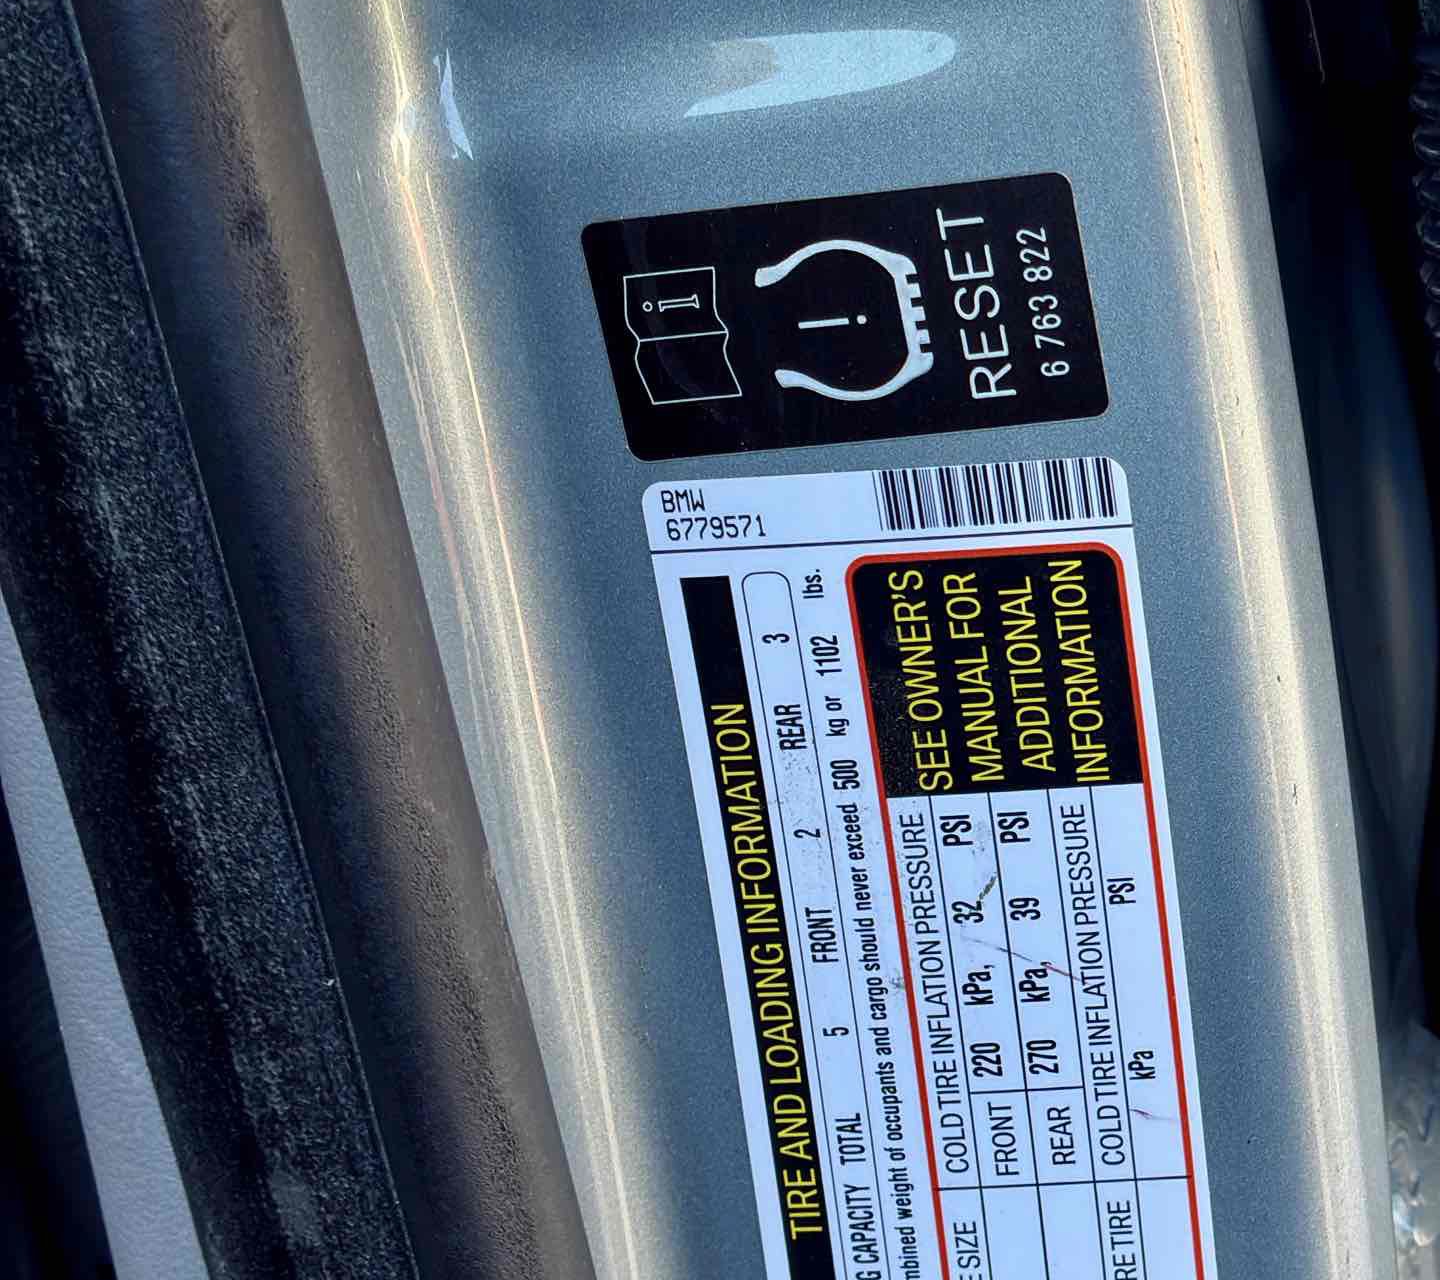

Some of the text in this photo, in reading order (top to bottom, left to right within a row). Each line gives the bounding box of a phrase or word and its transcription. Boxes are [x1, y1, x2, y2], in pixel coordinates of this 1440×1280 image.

[936, 208, 1016, 399] RESET
[1015, 227, 1070, 377] 6 763 822
[661, 489, 705, 513] BMW
[666, 514, 766, 542] 6779571
[802, 569, 824, 599] lbs.
[762, 633, 790, 644] 3
[810, 635, 842, 677] 1102
[888, 570, 953, 791] SEE OWNER'S
[942, 573, 1005, 782] MANUAL FOR
[997, 576, 1056, 772] ADDITIONAL
[1047, 560, 1110, 782] INFORMATION
[773, 704, 807, 751] REAR
[824, 695, 842, 711] or
[825, 719, 849, 736] kg
[830, 760, 860, 790] 500
[794, 828, 821, 839] 2
[837, 804, 865, 860] exceed
[850, 867, 872, 911] never
[805, 907, 839, 963] FRONT
[853, 918, 880, 971] should
[710, 703, 823, 1239] TIRE AND LOADING INFORMATION
[899, 814, 969, 1173] COLD TIRE INFLATION PRESSURE
[939, 814, 1019, 1176] FRONT 220 kPa, 32 PSI
[996, 811, 1076, 1166] REAR 270 kPa, 39 PSI
[1060, 804, 1125, 1166] COLD TIRE INFLATION PRESSURE
[1106, 877, 1157, 1080] kPa PSI
[861, 977, 888, 1021] cargo
[822, 1026, 849, 1037] 5
[869, 1027, 891, 1055] and
[876, 1061, 903, 1140] occupants
[835, 1113, 866, 1165] TOTAL
[884, 1144, 905, 1160] of
[888, 1167, 913, 1219] weight
[843, 1184, 879, 1264] CAPACITY
[953, 1221, 981, 1268] SIZE
[1106, 1201, 1133, 1250] TIRE
